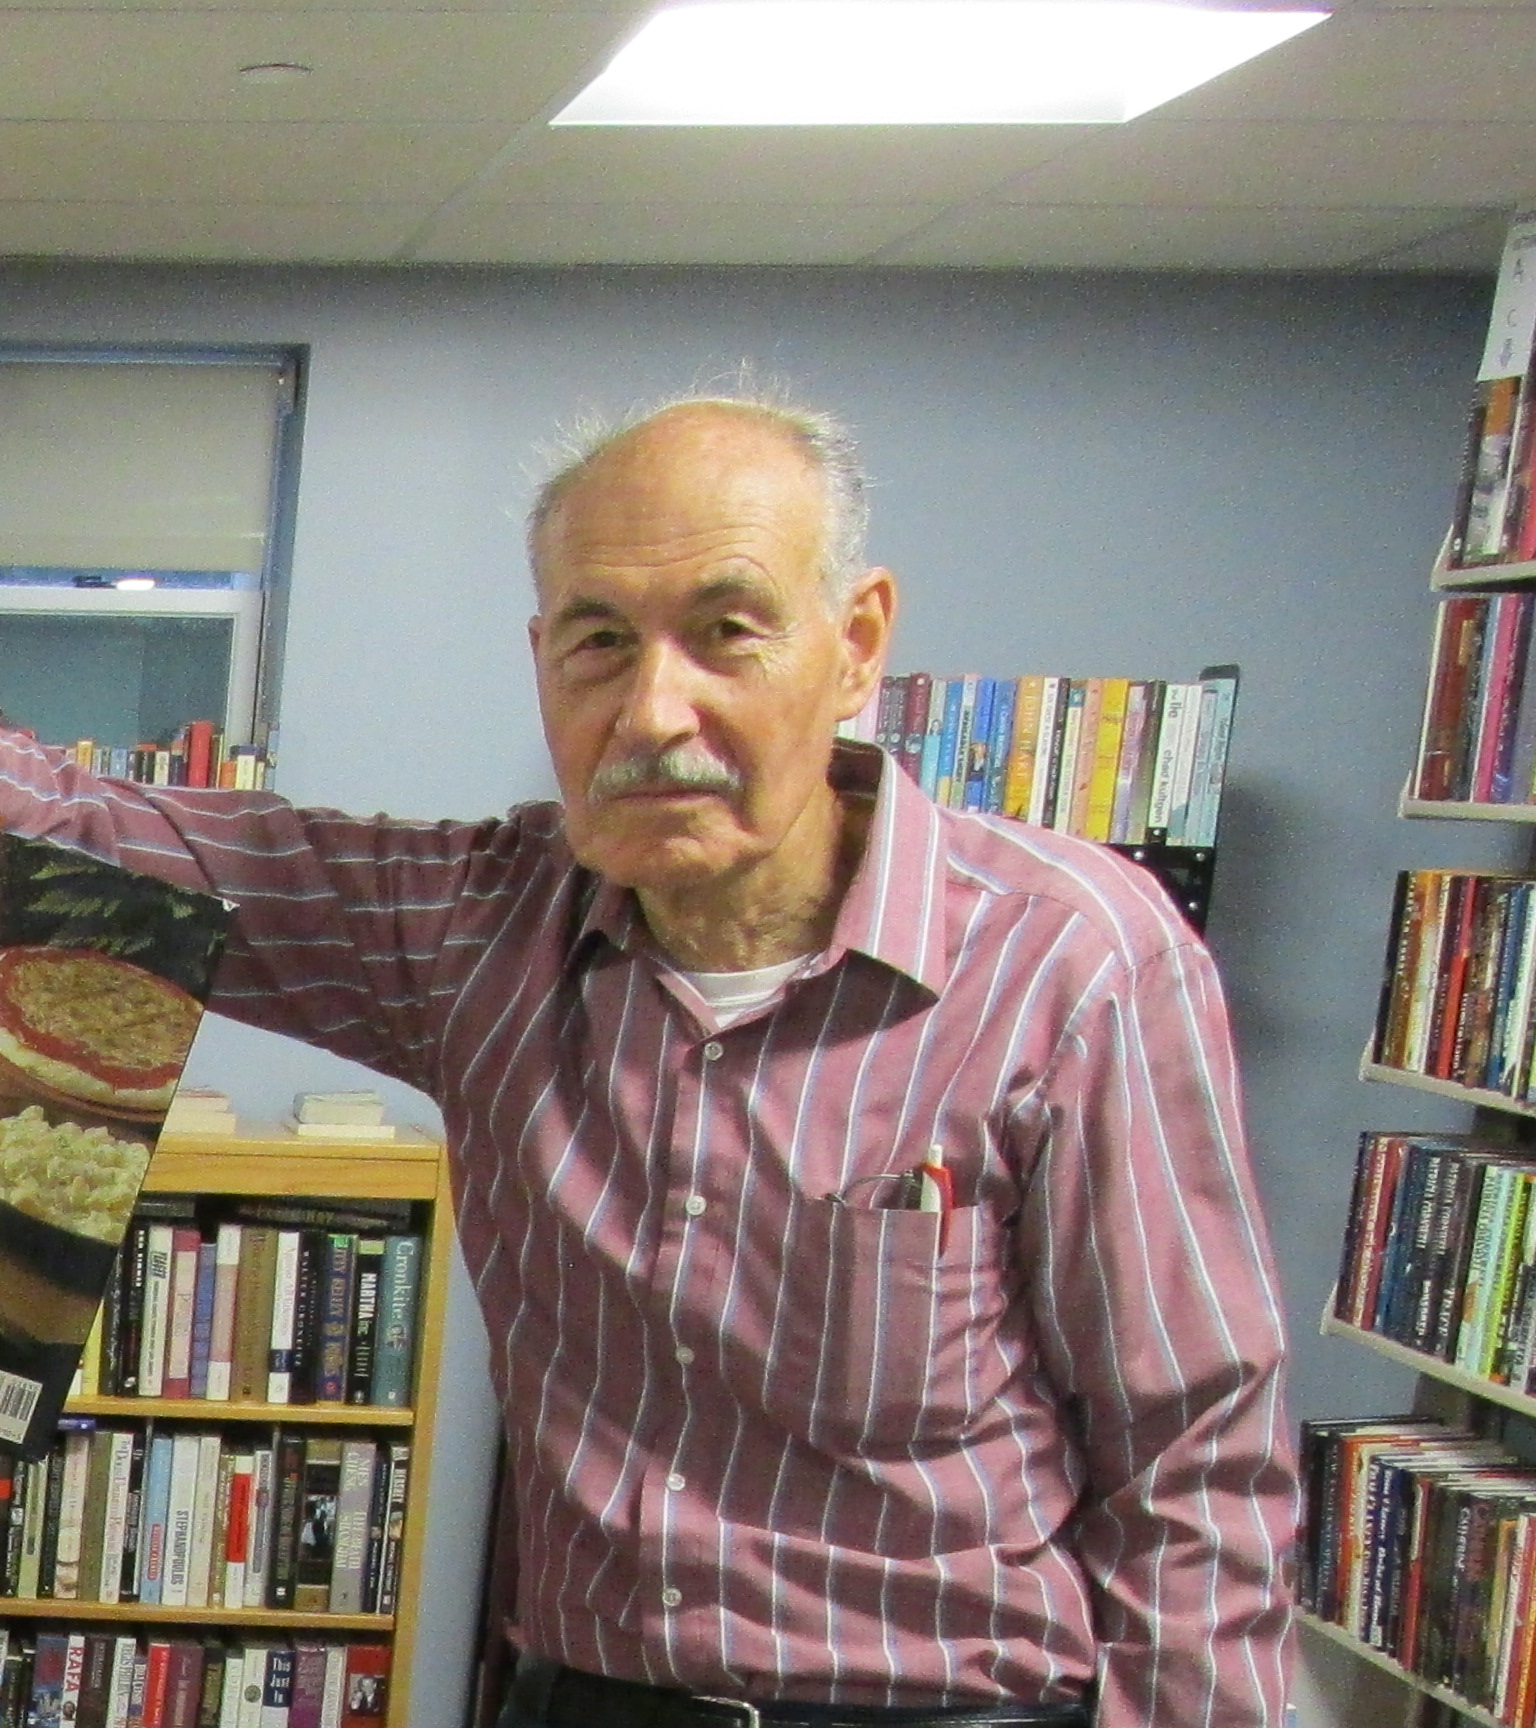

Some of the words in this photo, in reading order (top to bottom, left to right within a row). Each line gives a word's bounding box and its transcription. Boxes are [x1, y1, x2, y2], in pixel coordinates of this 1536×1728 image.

[1019, 696, 1037, 735] JOHN
[1016, 739, 1033, 779] HART
[1159, 749, 1175, 778] chad
[1153, 780, 1170, 824] kultgen
[358, 1272, 378, 1319] MARTHA
[391, 1241, 416, 1320] Cronkite
[65, 1646, 85, 1693] RAFA
[273, 1672, 290, 1689] Just
[274, 1656, 292, 1671] This
